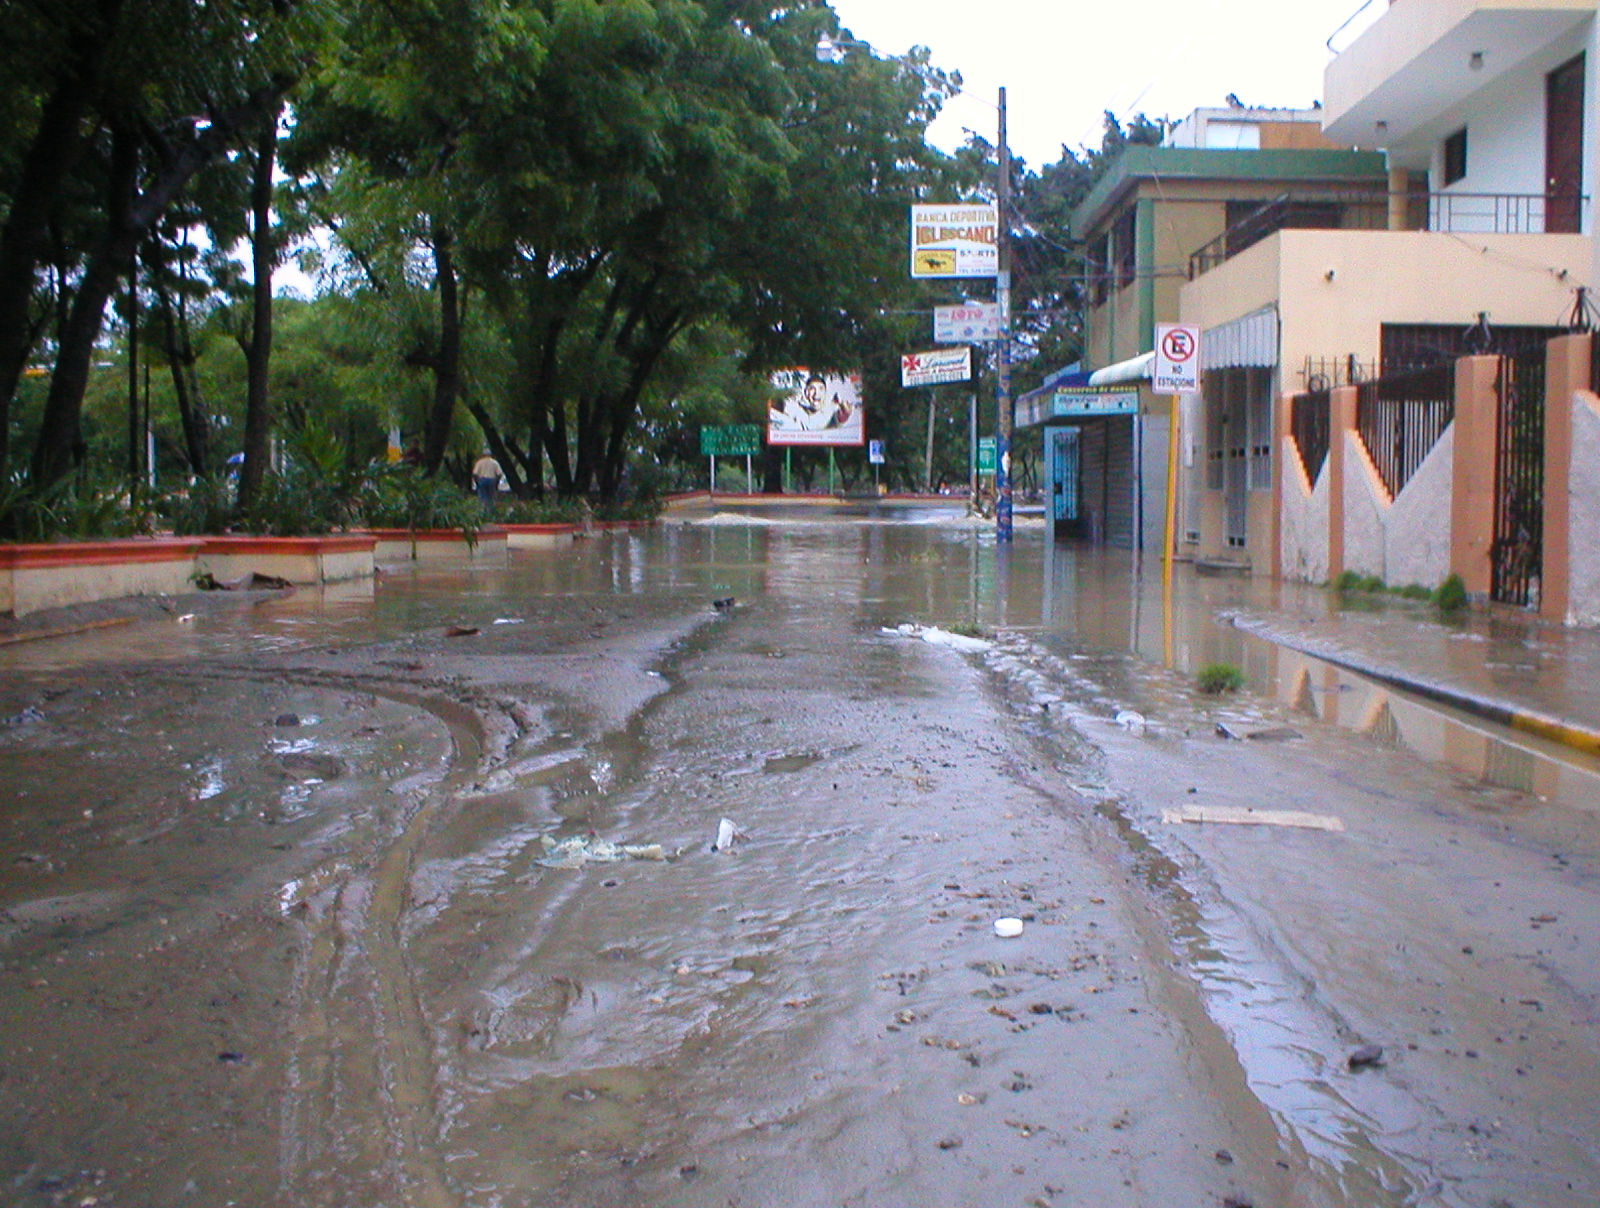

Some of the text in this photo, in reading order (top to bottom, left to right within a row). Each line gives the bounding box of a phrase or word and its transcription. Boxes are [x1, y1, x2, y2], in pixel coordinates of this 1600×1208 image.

[916, 210, 995, 222] BANCA DEPORTIVA
[951, 309, 983, 320] LOTO
[1172, 365, 1183, 375] NO
